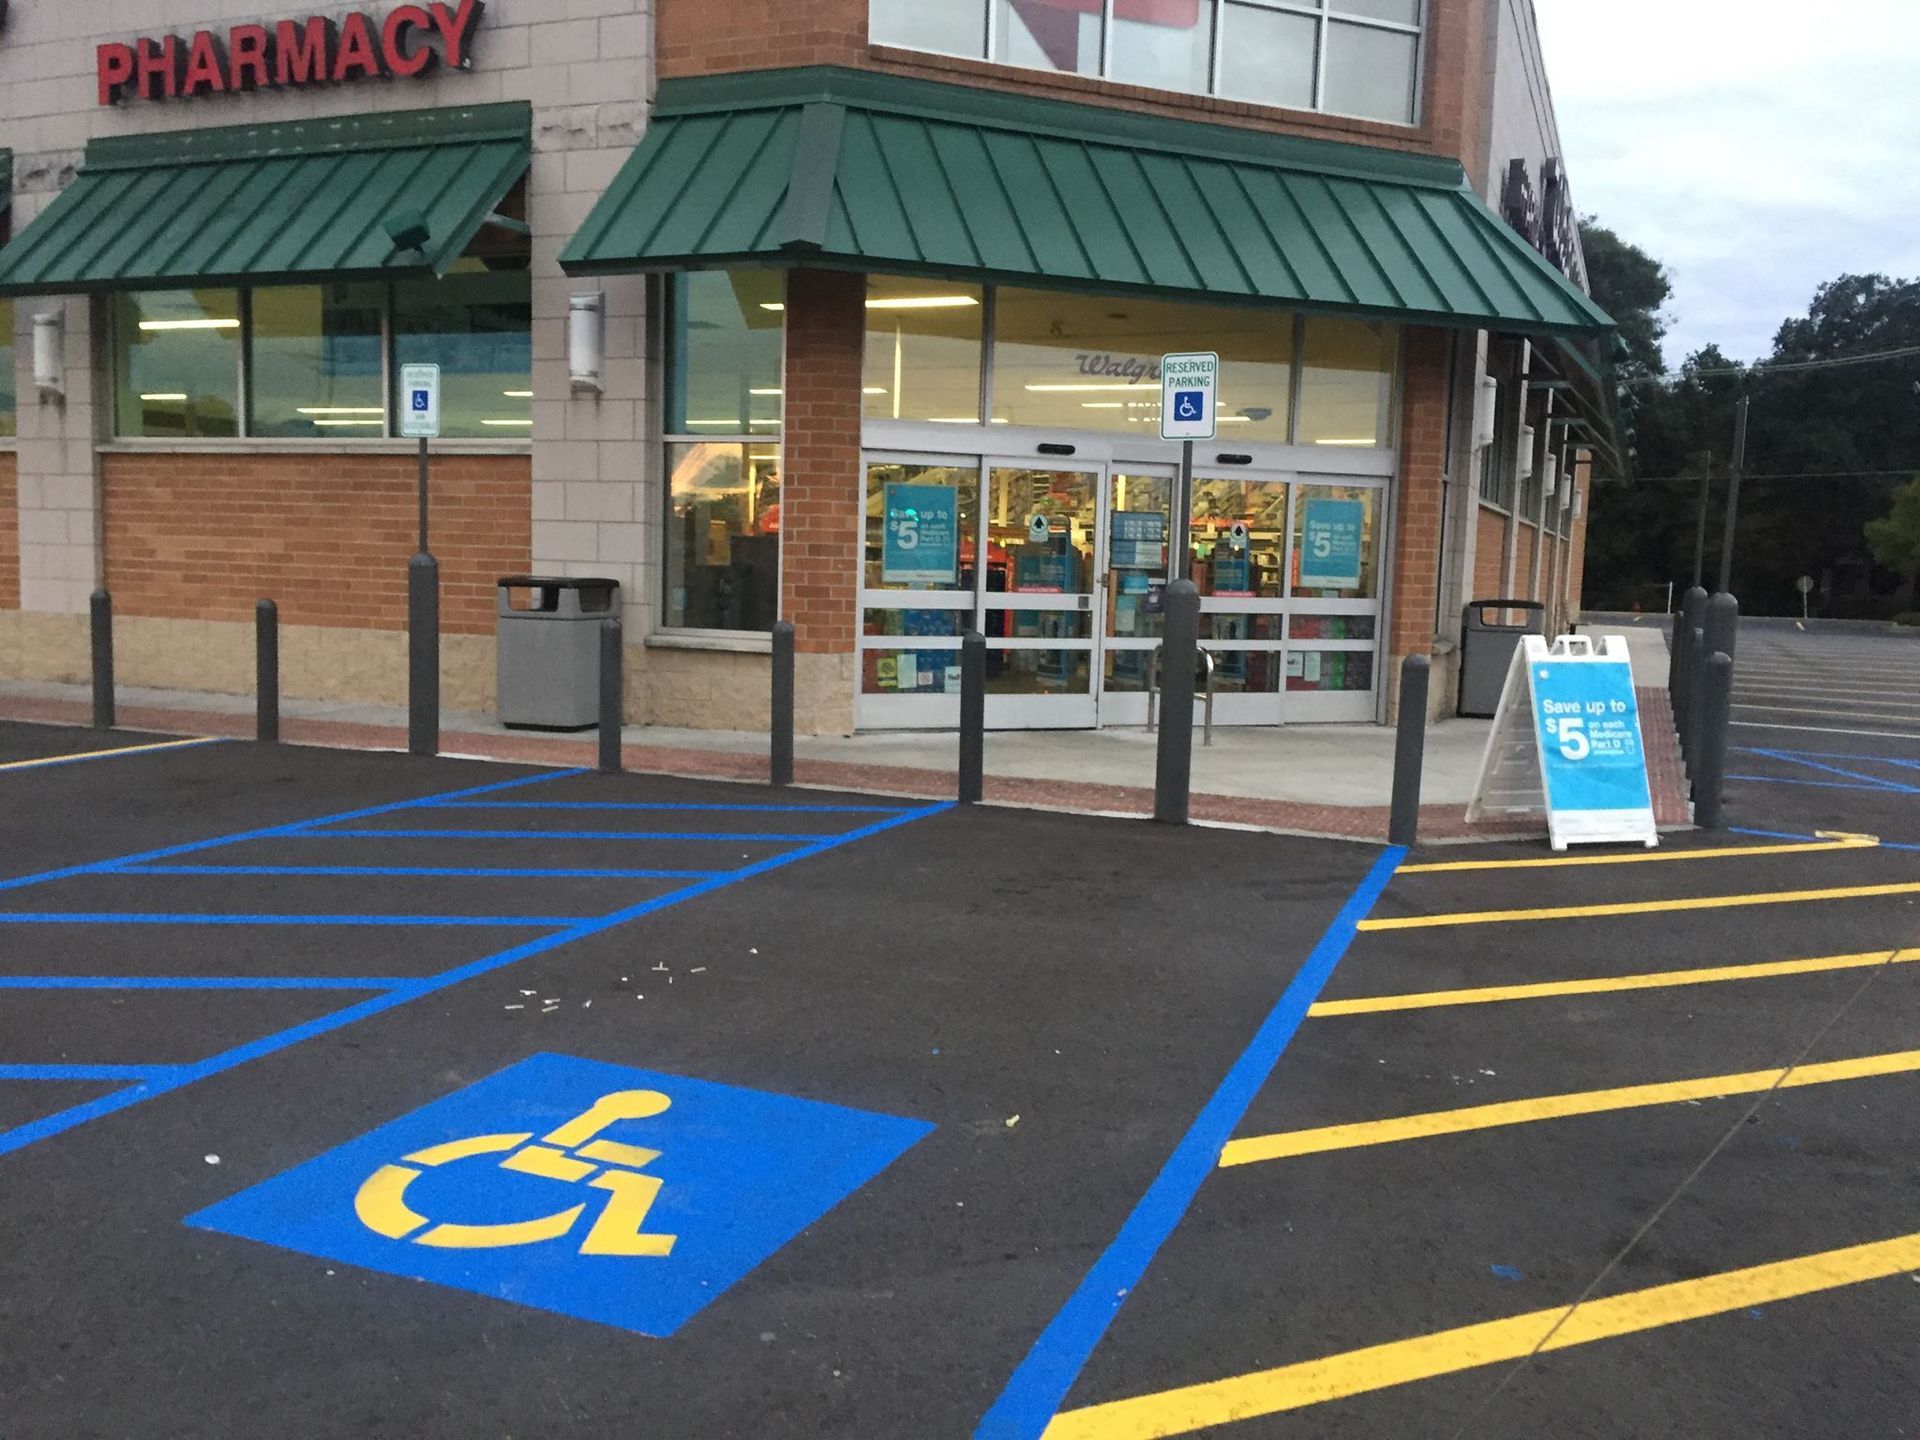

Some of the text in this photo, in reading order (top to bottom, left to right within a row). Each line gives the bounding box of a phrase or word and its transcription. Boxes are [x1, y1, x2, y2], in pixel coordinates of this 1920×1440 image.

[97, 0, 476, 106] PHARMACY
[1074, 353, 1162, 384] Walgr
[1166, 361, 1214, 373] RESERVED
[1168, 376, 1210, 388] PARKING
[920, 511, 934, 521] up
[1543, 699, 1626, 716] Save up to
[1545, 717, 1590, 760] $5
